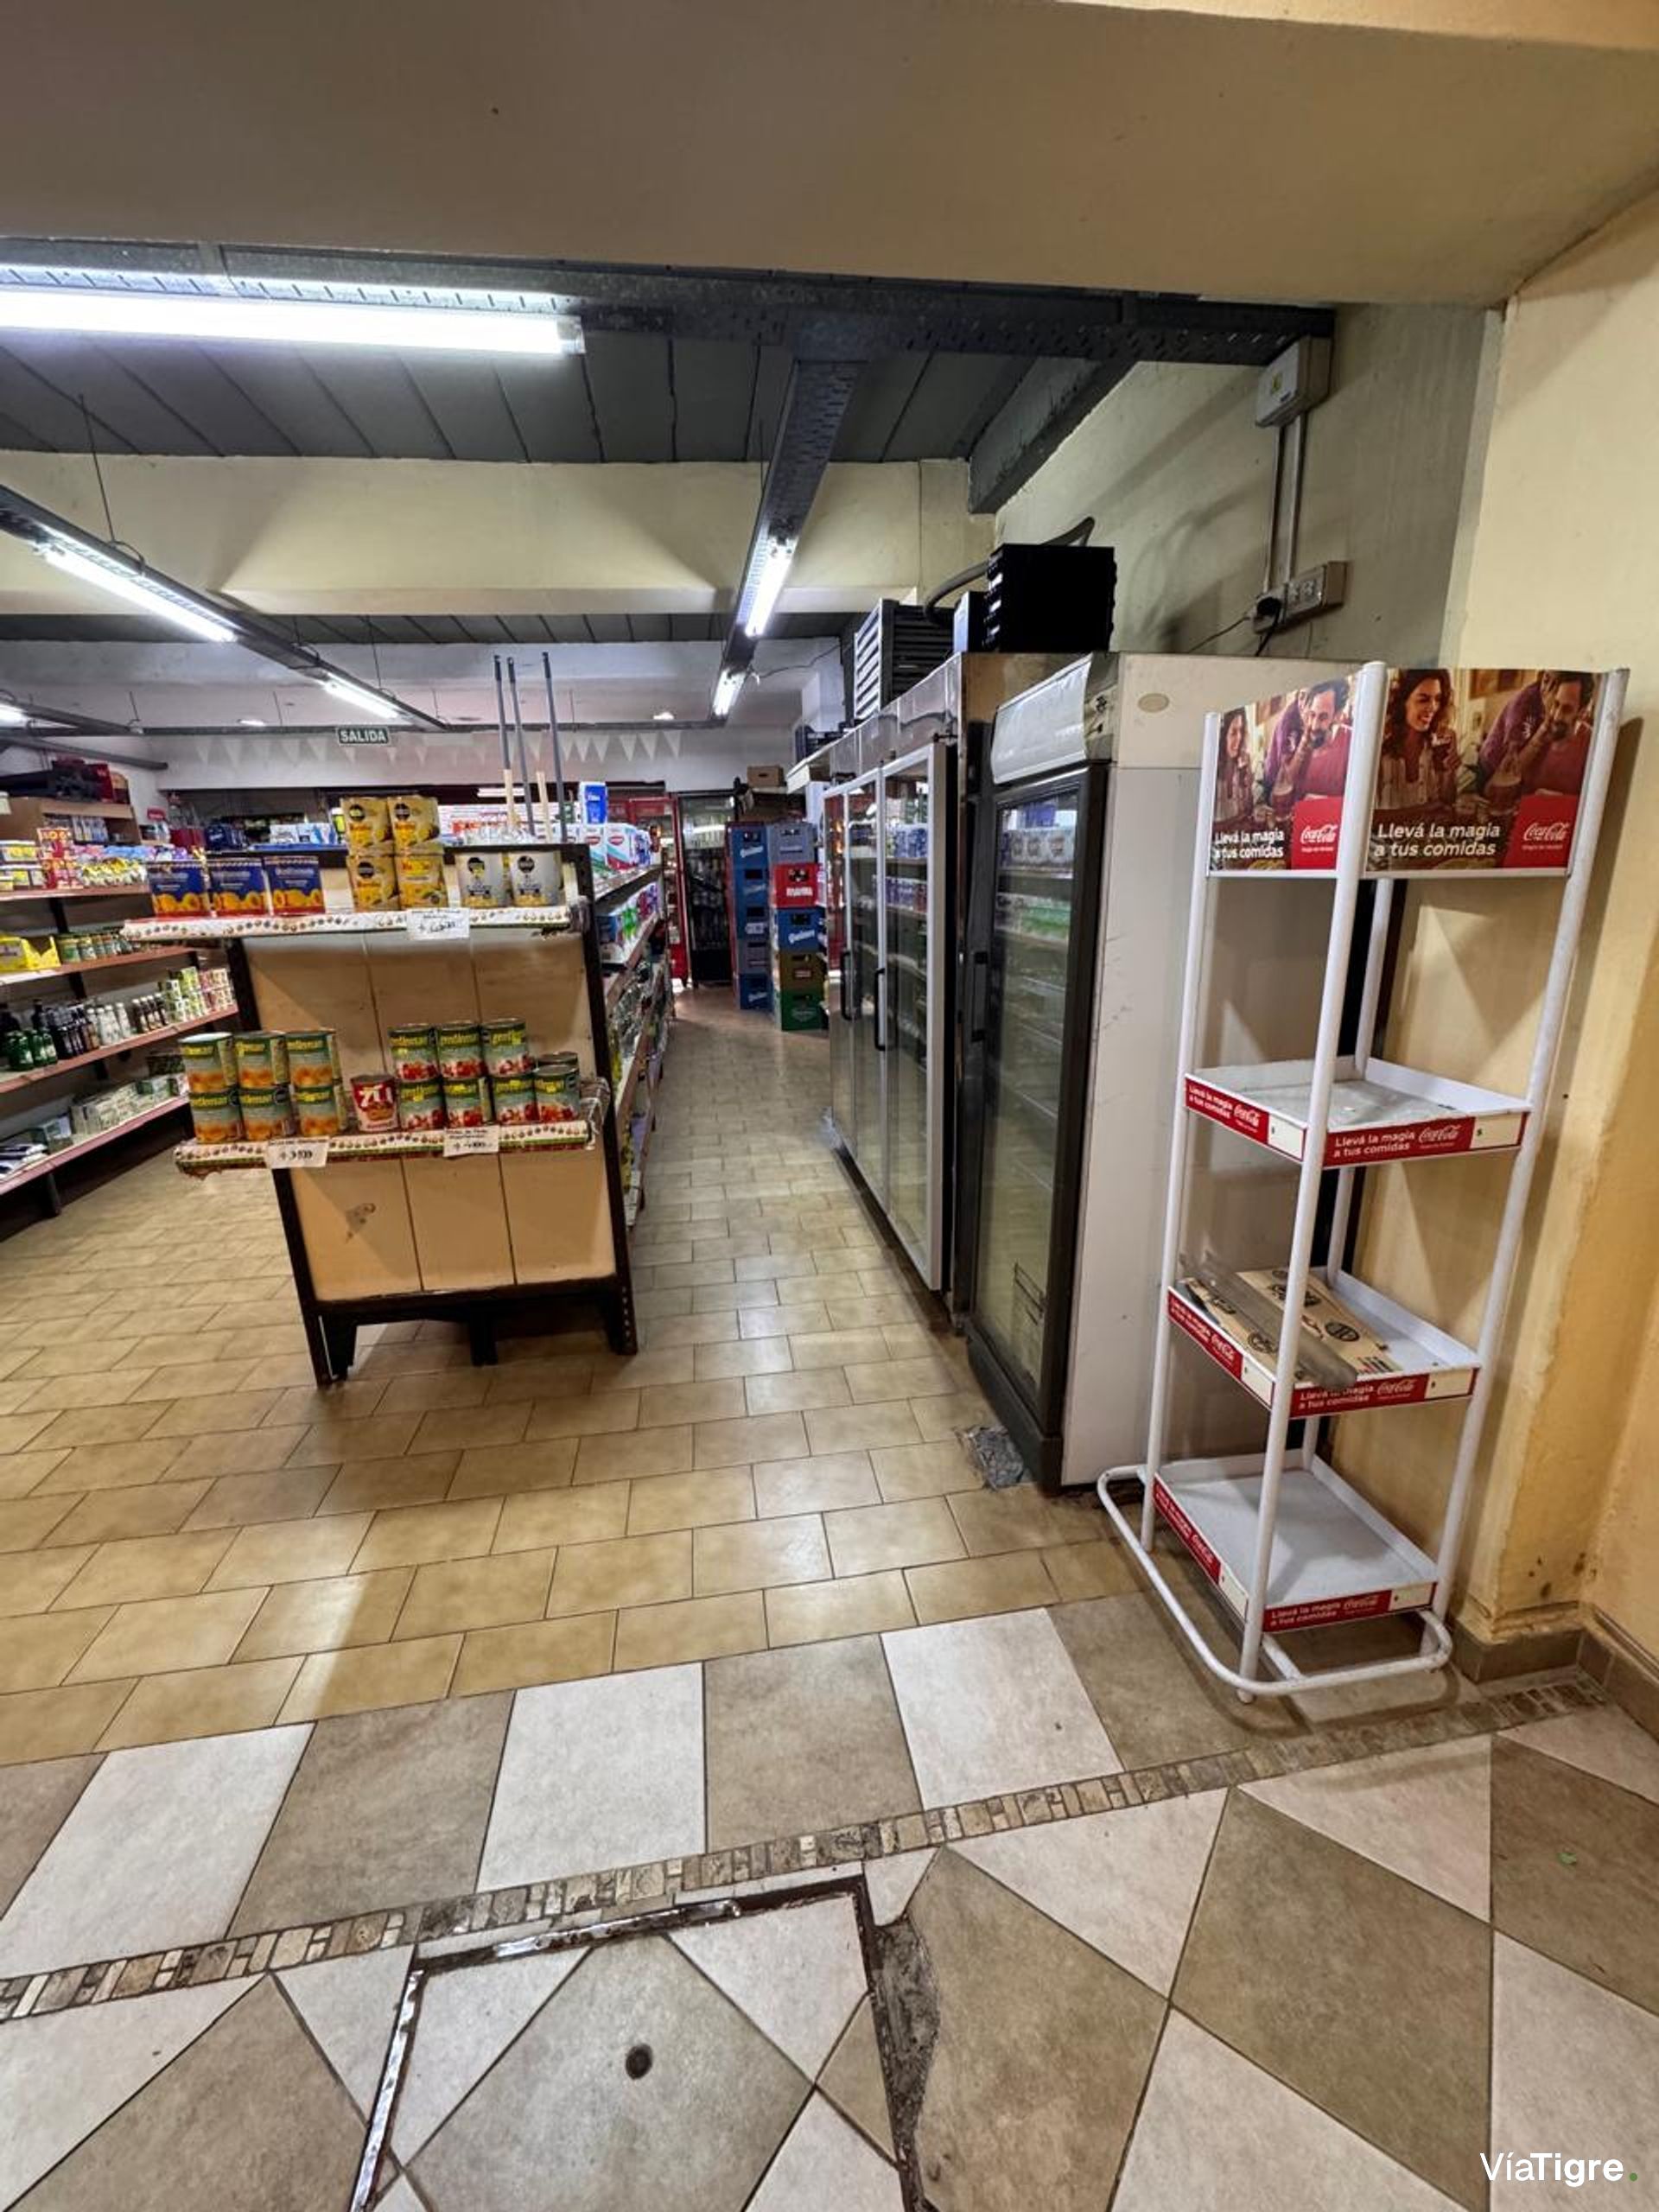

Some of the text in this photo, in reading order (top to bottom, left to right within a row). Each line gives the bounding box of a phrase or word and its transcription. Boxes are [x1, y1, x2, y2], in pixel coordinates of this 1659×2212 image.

[340, 729, 386, 742] SALIDA
[1241, 830, 1252, 843] la
[1253, 828, 1284, 845] magia
[1300, 823, 1338, 844] Coca-Cola
[1378, 822, 1501, 840] Llevá la magia
[1523, 822, 1570, 841] Coca-Cola
[1223, 847, 1237, 859] tus
[1239, 845, 1284, 859] comidas
[1374, 841, 1496, 856] a tus comidas
[1369, 1135, 1379, 1144] la
[1382, 1130, 1415, 1142] magia
[1418, 1124, 1460, 1143] Coca-Cola
[1344, 1147, 1362, 1157] tus
[1363, 1142, 1410, 1154] comidas
